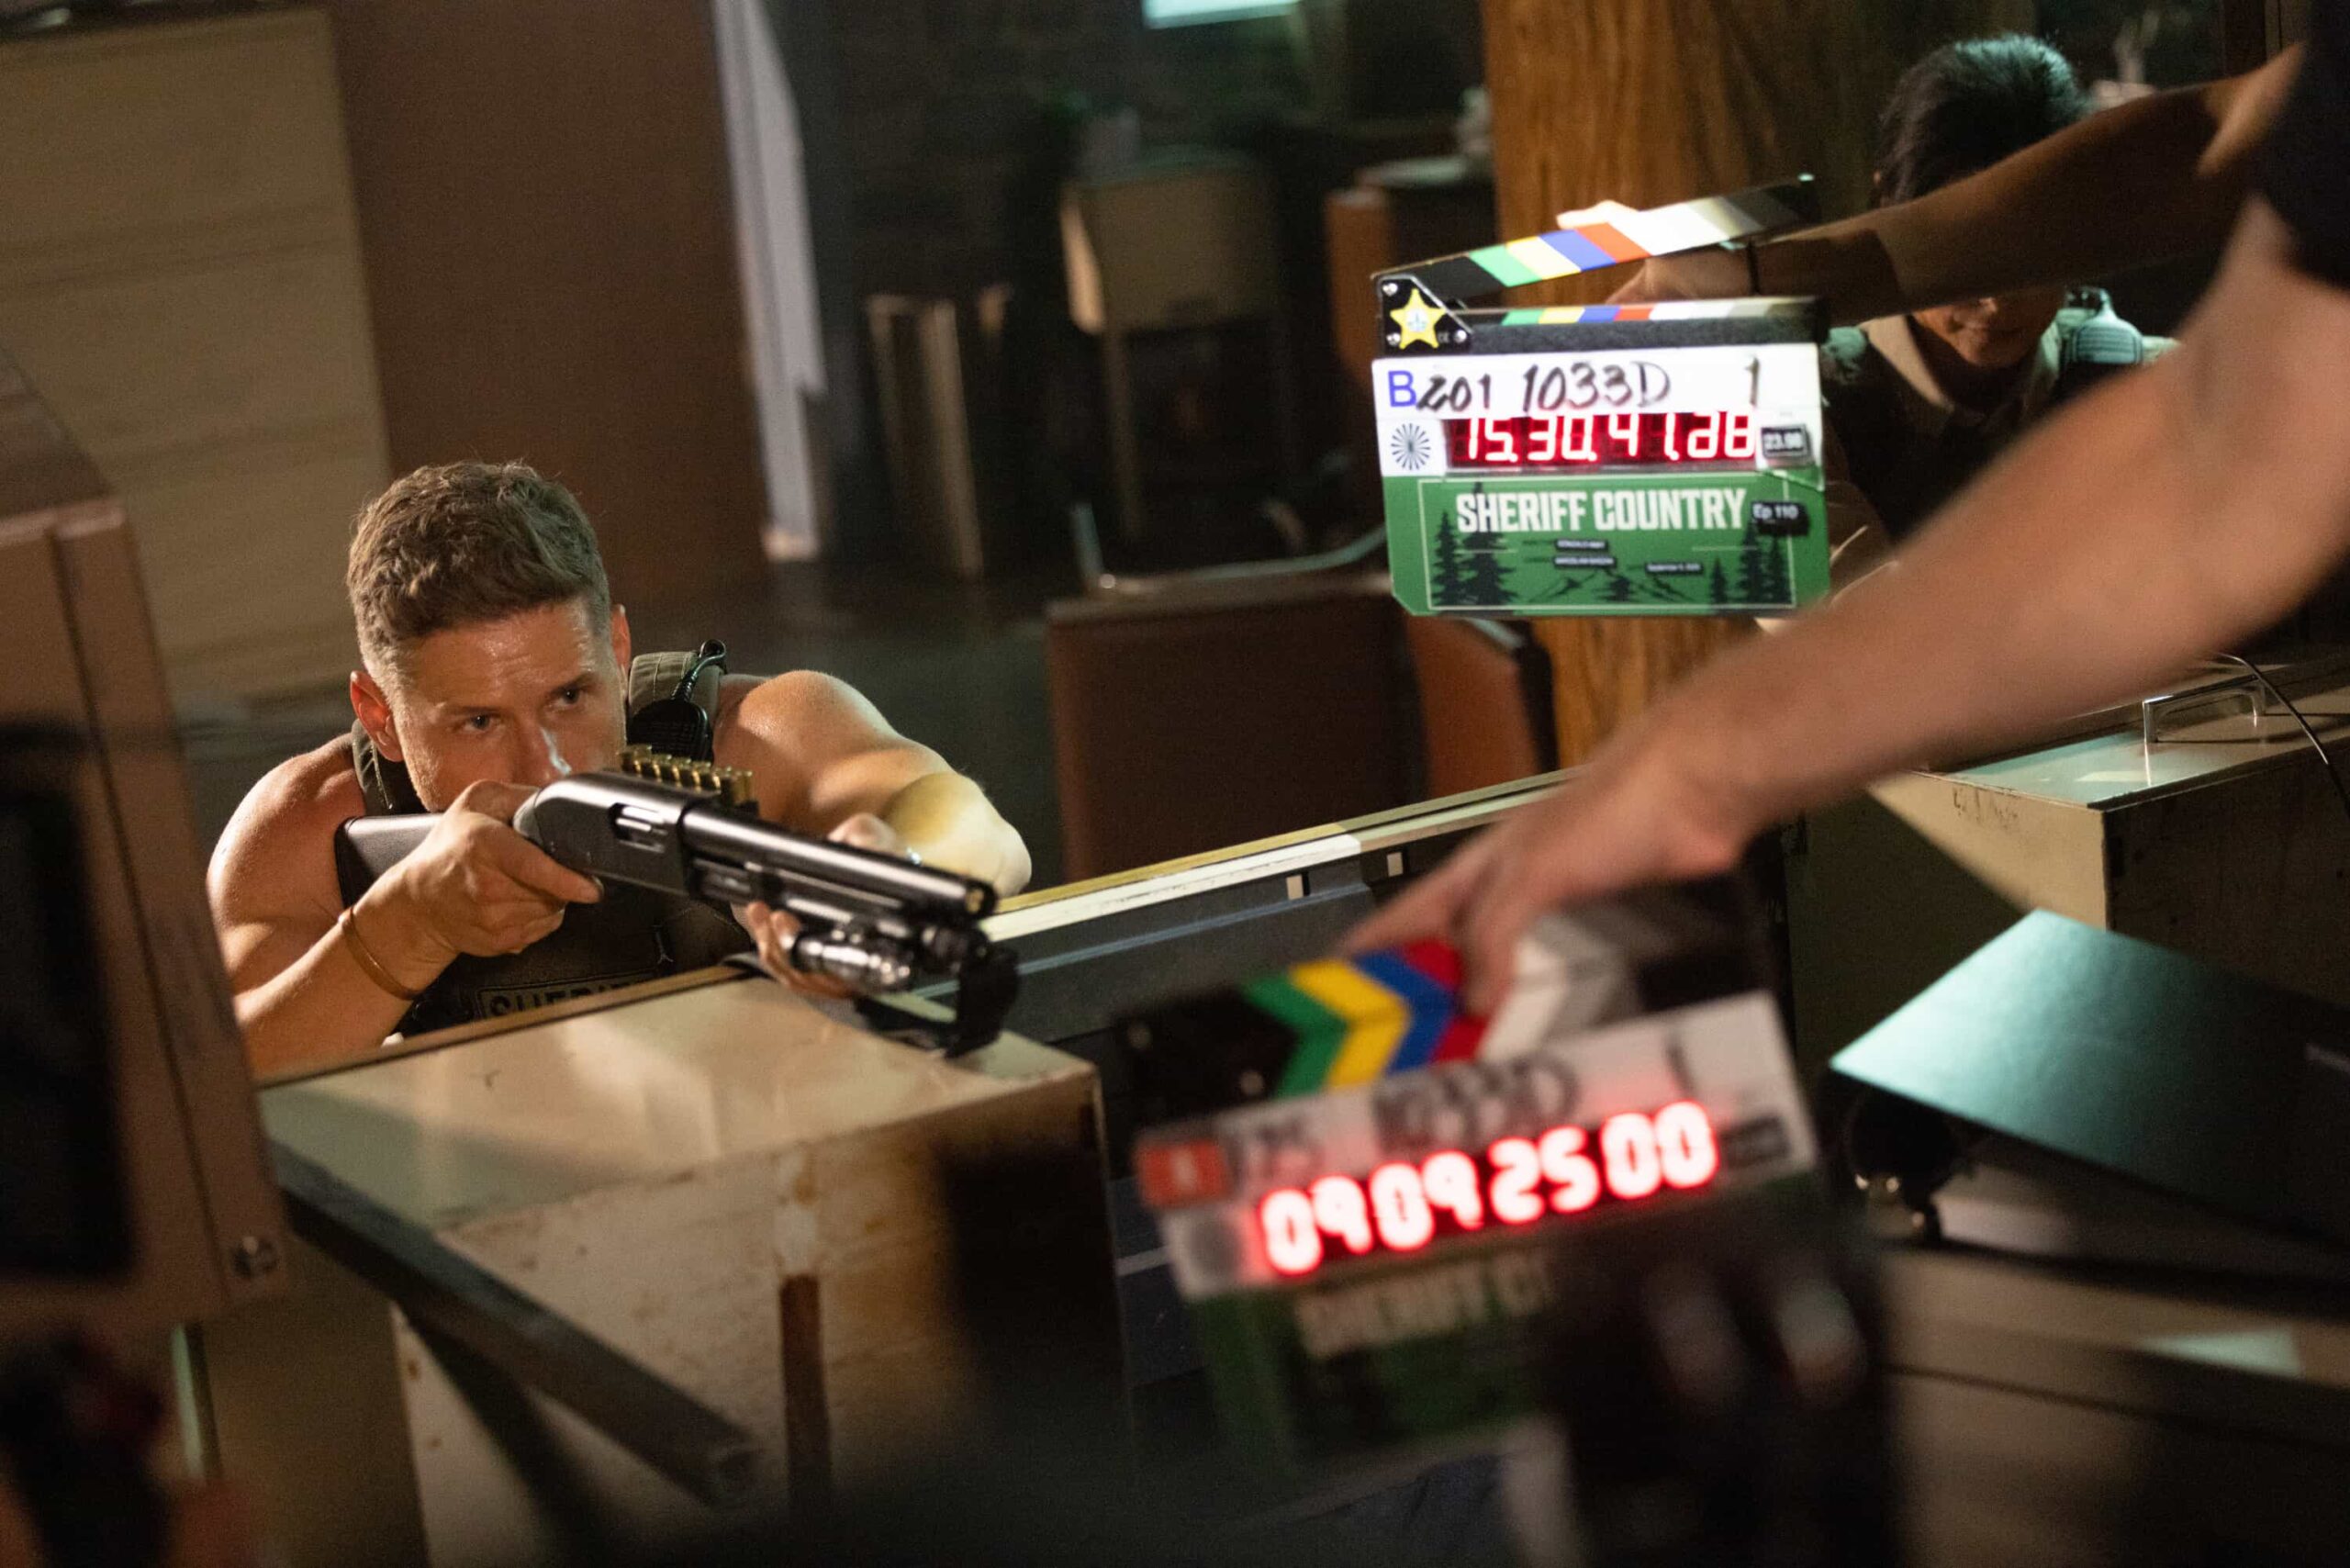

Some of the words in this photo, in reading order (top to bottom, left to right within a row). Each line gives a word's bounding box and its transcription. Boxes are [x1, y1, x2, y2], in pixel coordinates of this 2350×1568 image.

[1388, 370, 1417, 408] B
[1522, 360, 1672, 413] 1033D
[1745, 357, 1760, 407] 1
[1456, 491, 1587, 533] SHERIFF
[1592, 488, 1747, 532] COUNTRY
